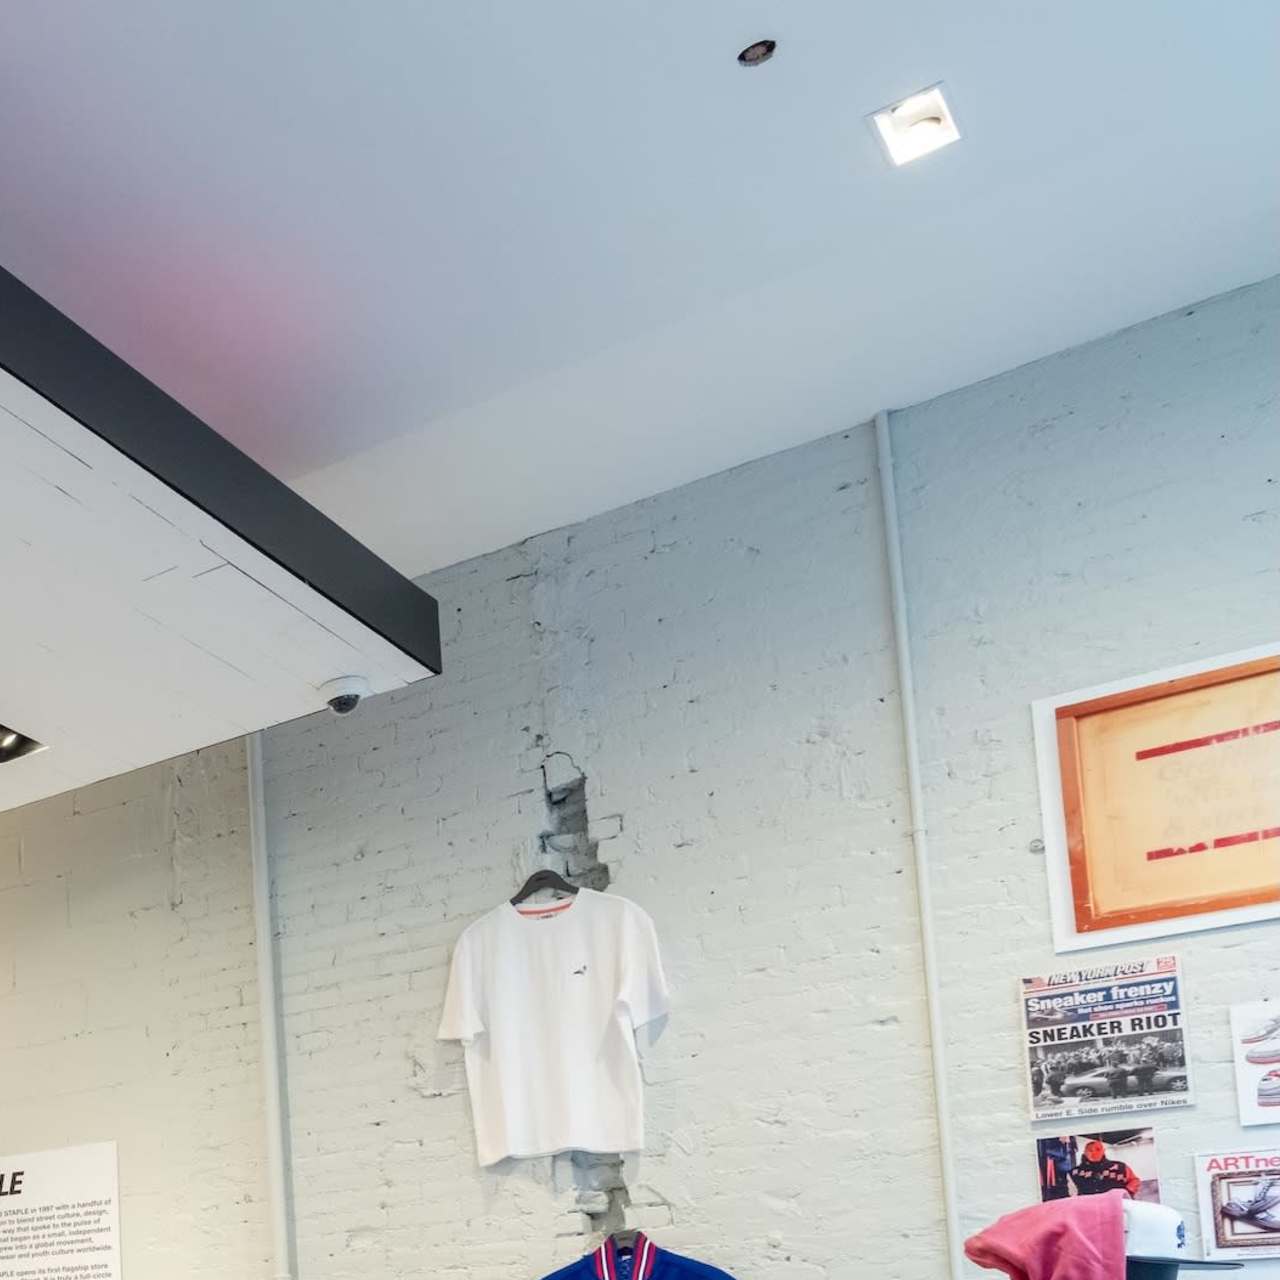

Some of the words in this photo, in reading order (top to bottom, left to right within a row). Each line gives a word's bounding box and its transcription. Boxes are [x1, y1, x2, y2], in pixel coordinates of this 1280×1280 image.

[1048, 972, 1077, 986] NEW
[1078, 966, 1116, 983] YORK
[1115, 961, 1147, 976] POST
[1027, 990, 1106, 1013] Sneaker
[1111, 981, 1175, 1001] frenzy
[1028, 1020, 1122, 1044] SNEAKER
[1131, 1012, 1181, 1032] RIOT
[1035, 1110, 1063, 1119] Lower
[1078, 1106, 1099, 1115] Side
[1101, 1103, 1134, 1113] rumble
[1136, 1101, 1158, 1109] over
[1160, 1098, 1188, 1106] Nikes
